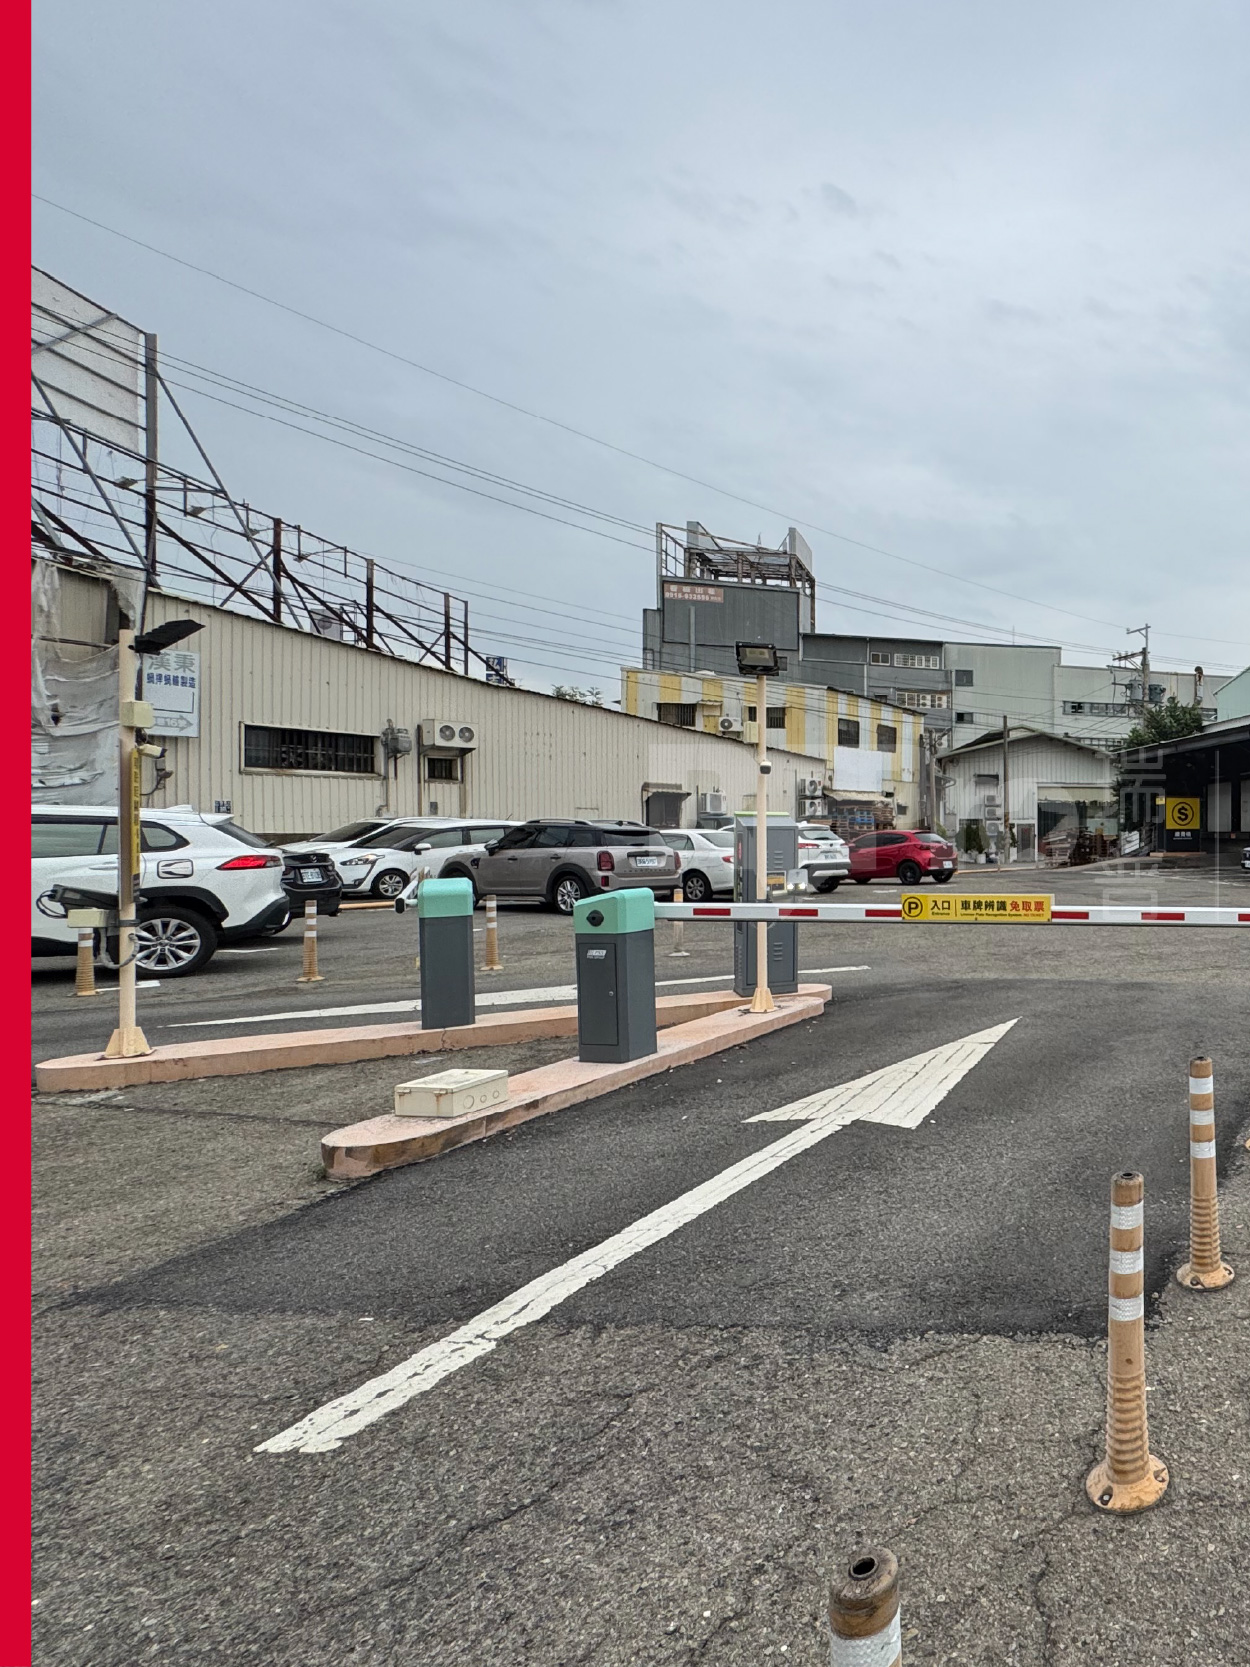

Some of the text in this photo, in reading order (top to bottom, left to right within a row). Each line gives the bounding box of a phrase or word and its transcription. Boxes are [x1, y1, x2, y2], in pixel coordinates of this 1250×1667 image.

[930, 900, 951, 911] 入口
[960, 899, 1045, 912] 車牌辨識 免取票
